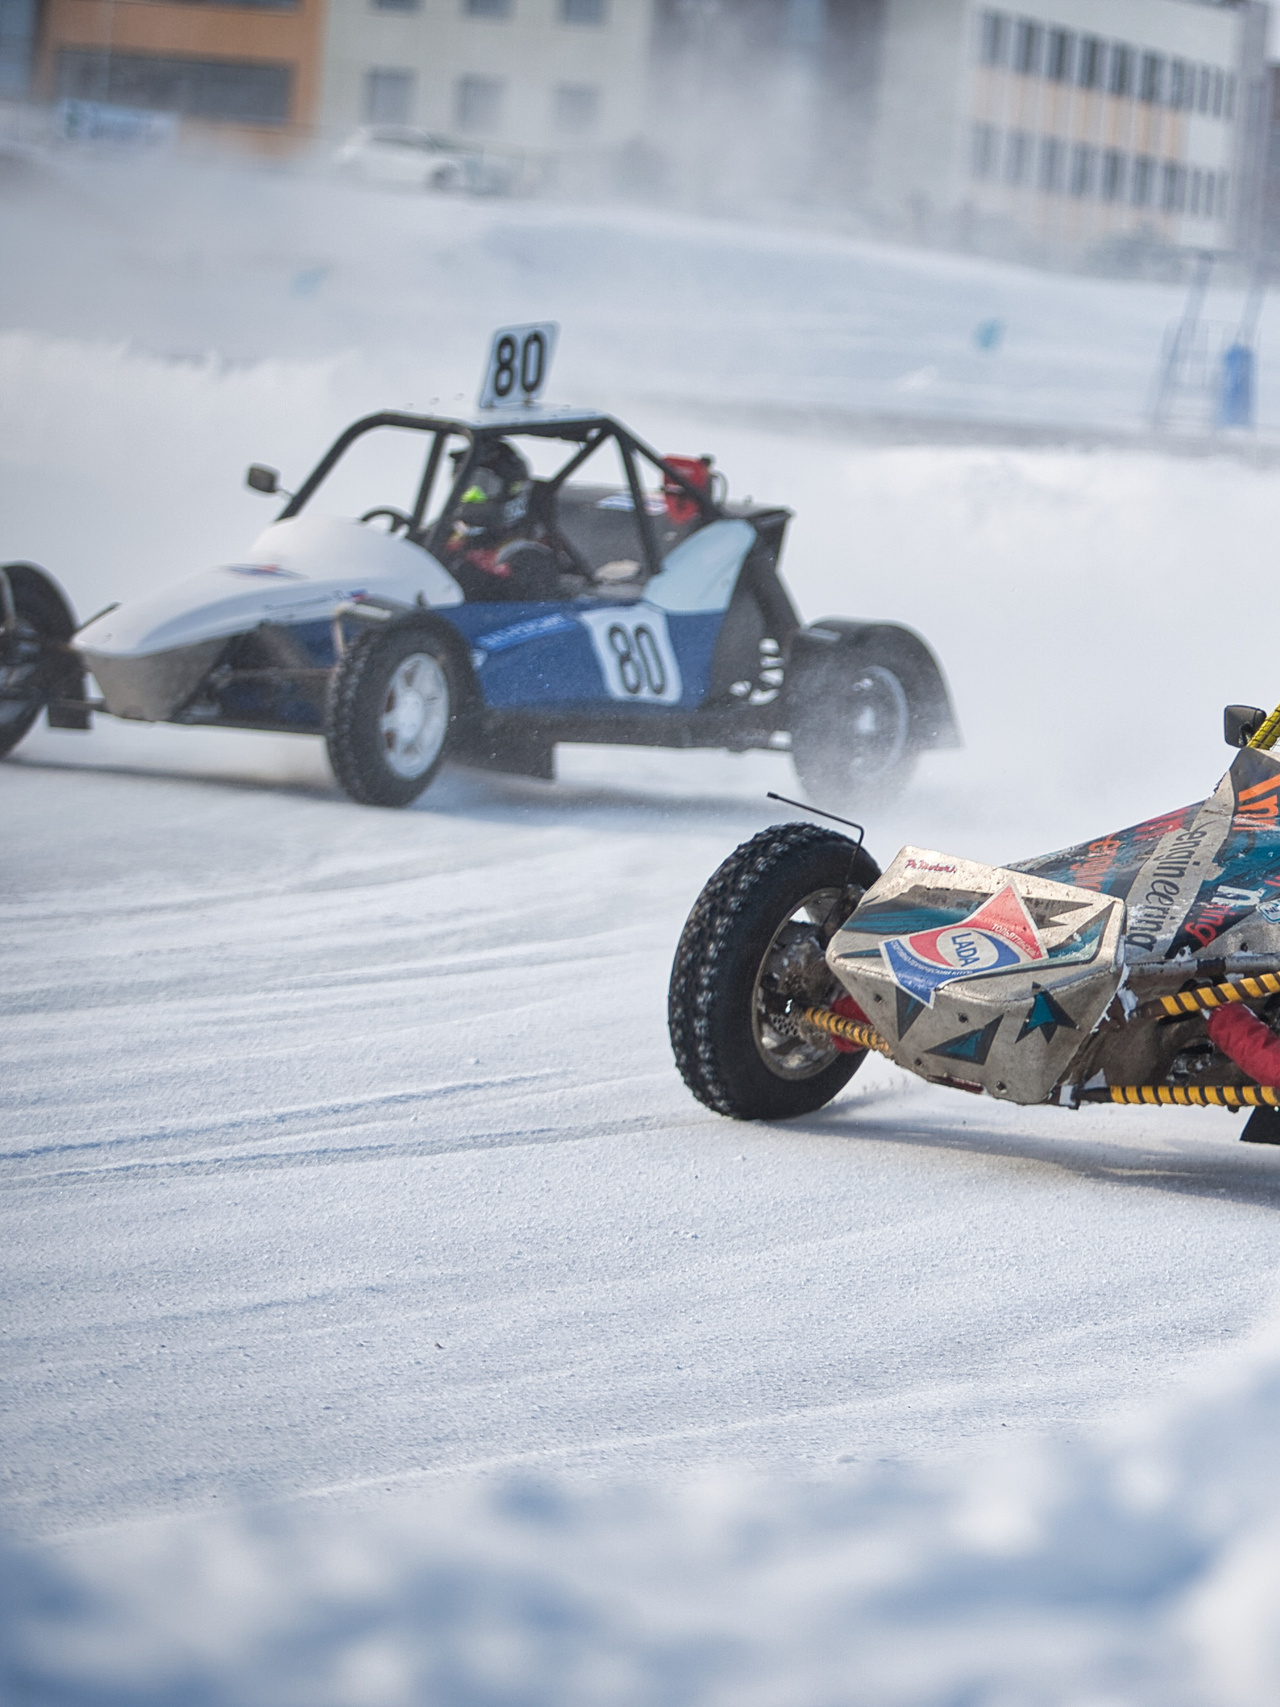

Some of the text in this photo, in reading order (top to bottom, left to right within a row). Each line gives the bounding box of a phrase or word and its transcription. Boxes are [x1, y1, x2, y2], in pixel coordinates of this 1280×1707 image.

[493, 331, 545, 398] 80
[608, 624, 666, 695] 80
[951, 932, 982, 968] LADA
